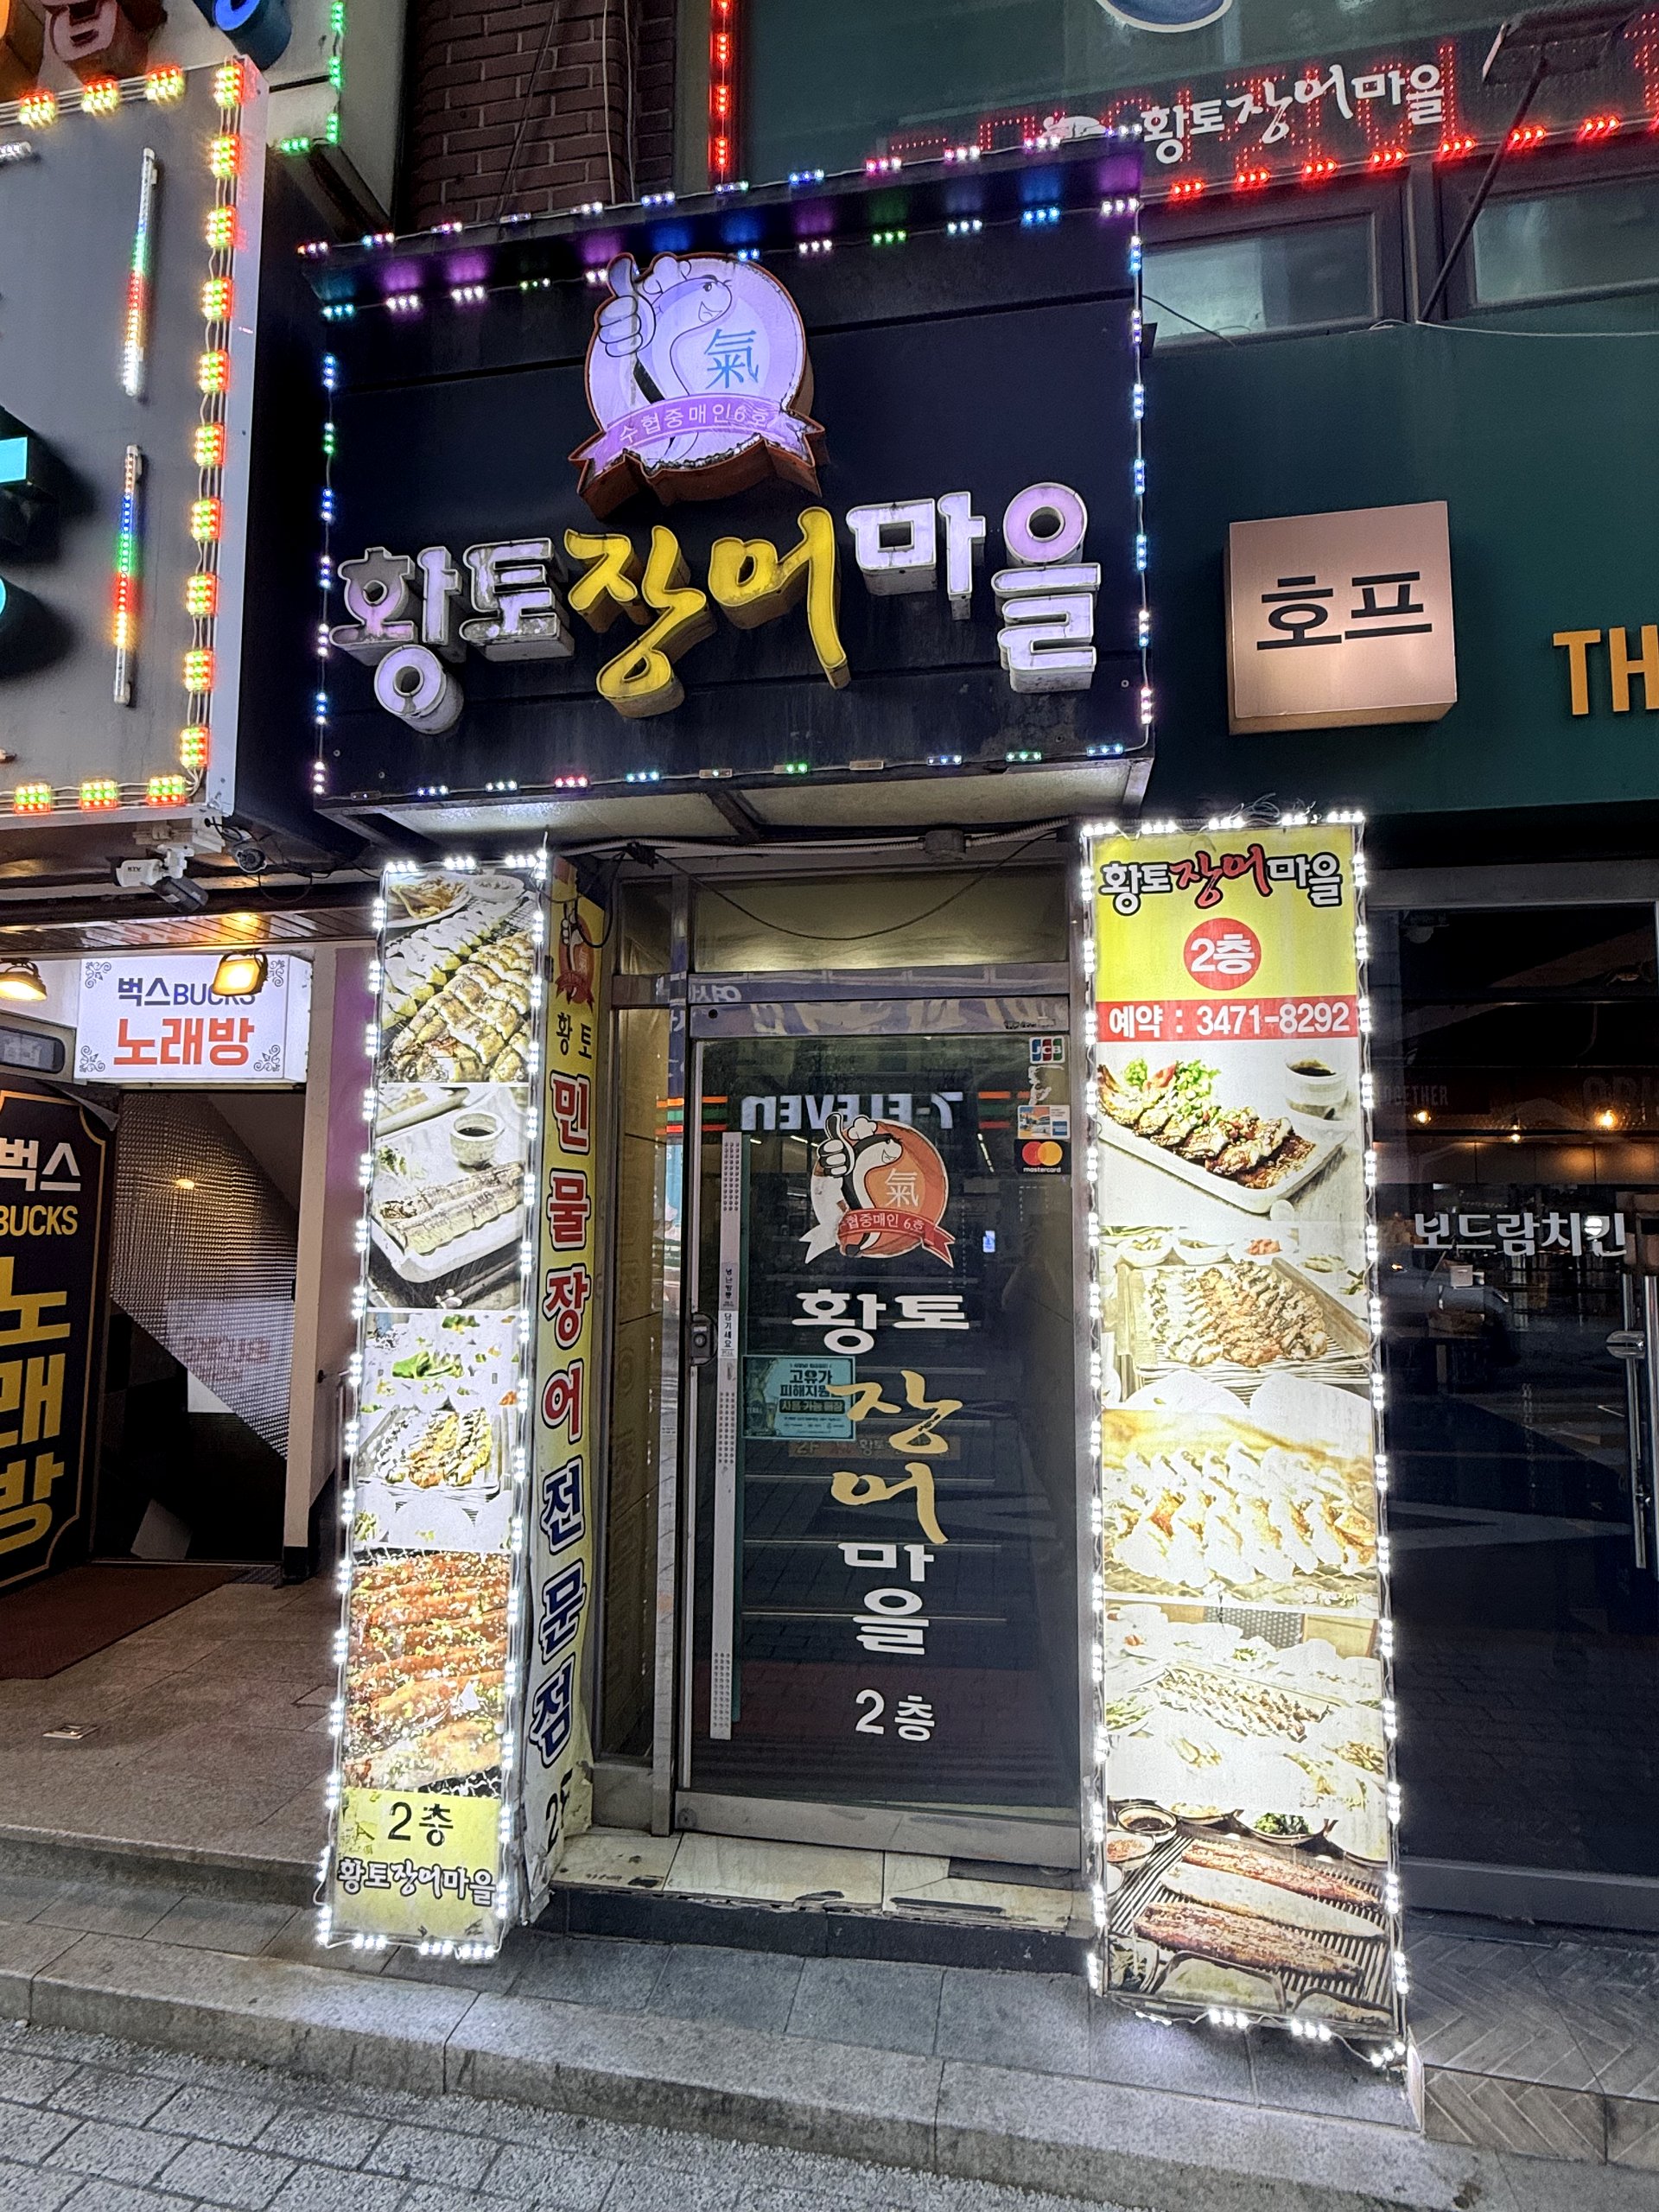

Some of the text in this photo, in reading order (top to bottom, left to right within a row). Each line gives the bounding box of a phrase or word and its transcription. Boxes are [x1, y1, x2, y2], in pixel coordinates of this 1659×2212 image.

[1141, 64, 1446, 164] 황토장어마을
[703, 327, 759, 390] 氣
[328, 482, 1103, 723] 황토장어마을
[1256, 571, 1433, 651] 호프
[1553, 624, 1659, 715] TH
[1098, 842, 1343, 917] 황토장어마을
[1190, 933, 1255, 975] 2층
[113, 1017, 255, 1066] 노래방
[556, 1012, 593, 1061] 황토
[1109, 1001, 1350, 1038] 예약 : 3471-8292
[884, 1167, 919, 1208] 氣
[840, 1212, 899, 1232] 협중매인
[1414, 1212, 1627, 1257] 보드람치킨
[791, 1288, 969, 1355] 황토
[780, 1384, 843, 1398] 피해지원
[789, 1370, 833, 1384] 고유가
[528, 1070, 591, 1769] 민물장어 전문점
[854, 1688, 937, 1742] 2층
[387, 1801, 454, 1847] 2층
[336, 1856, 498, 1907] 황토장어마을
